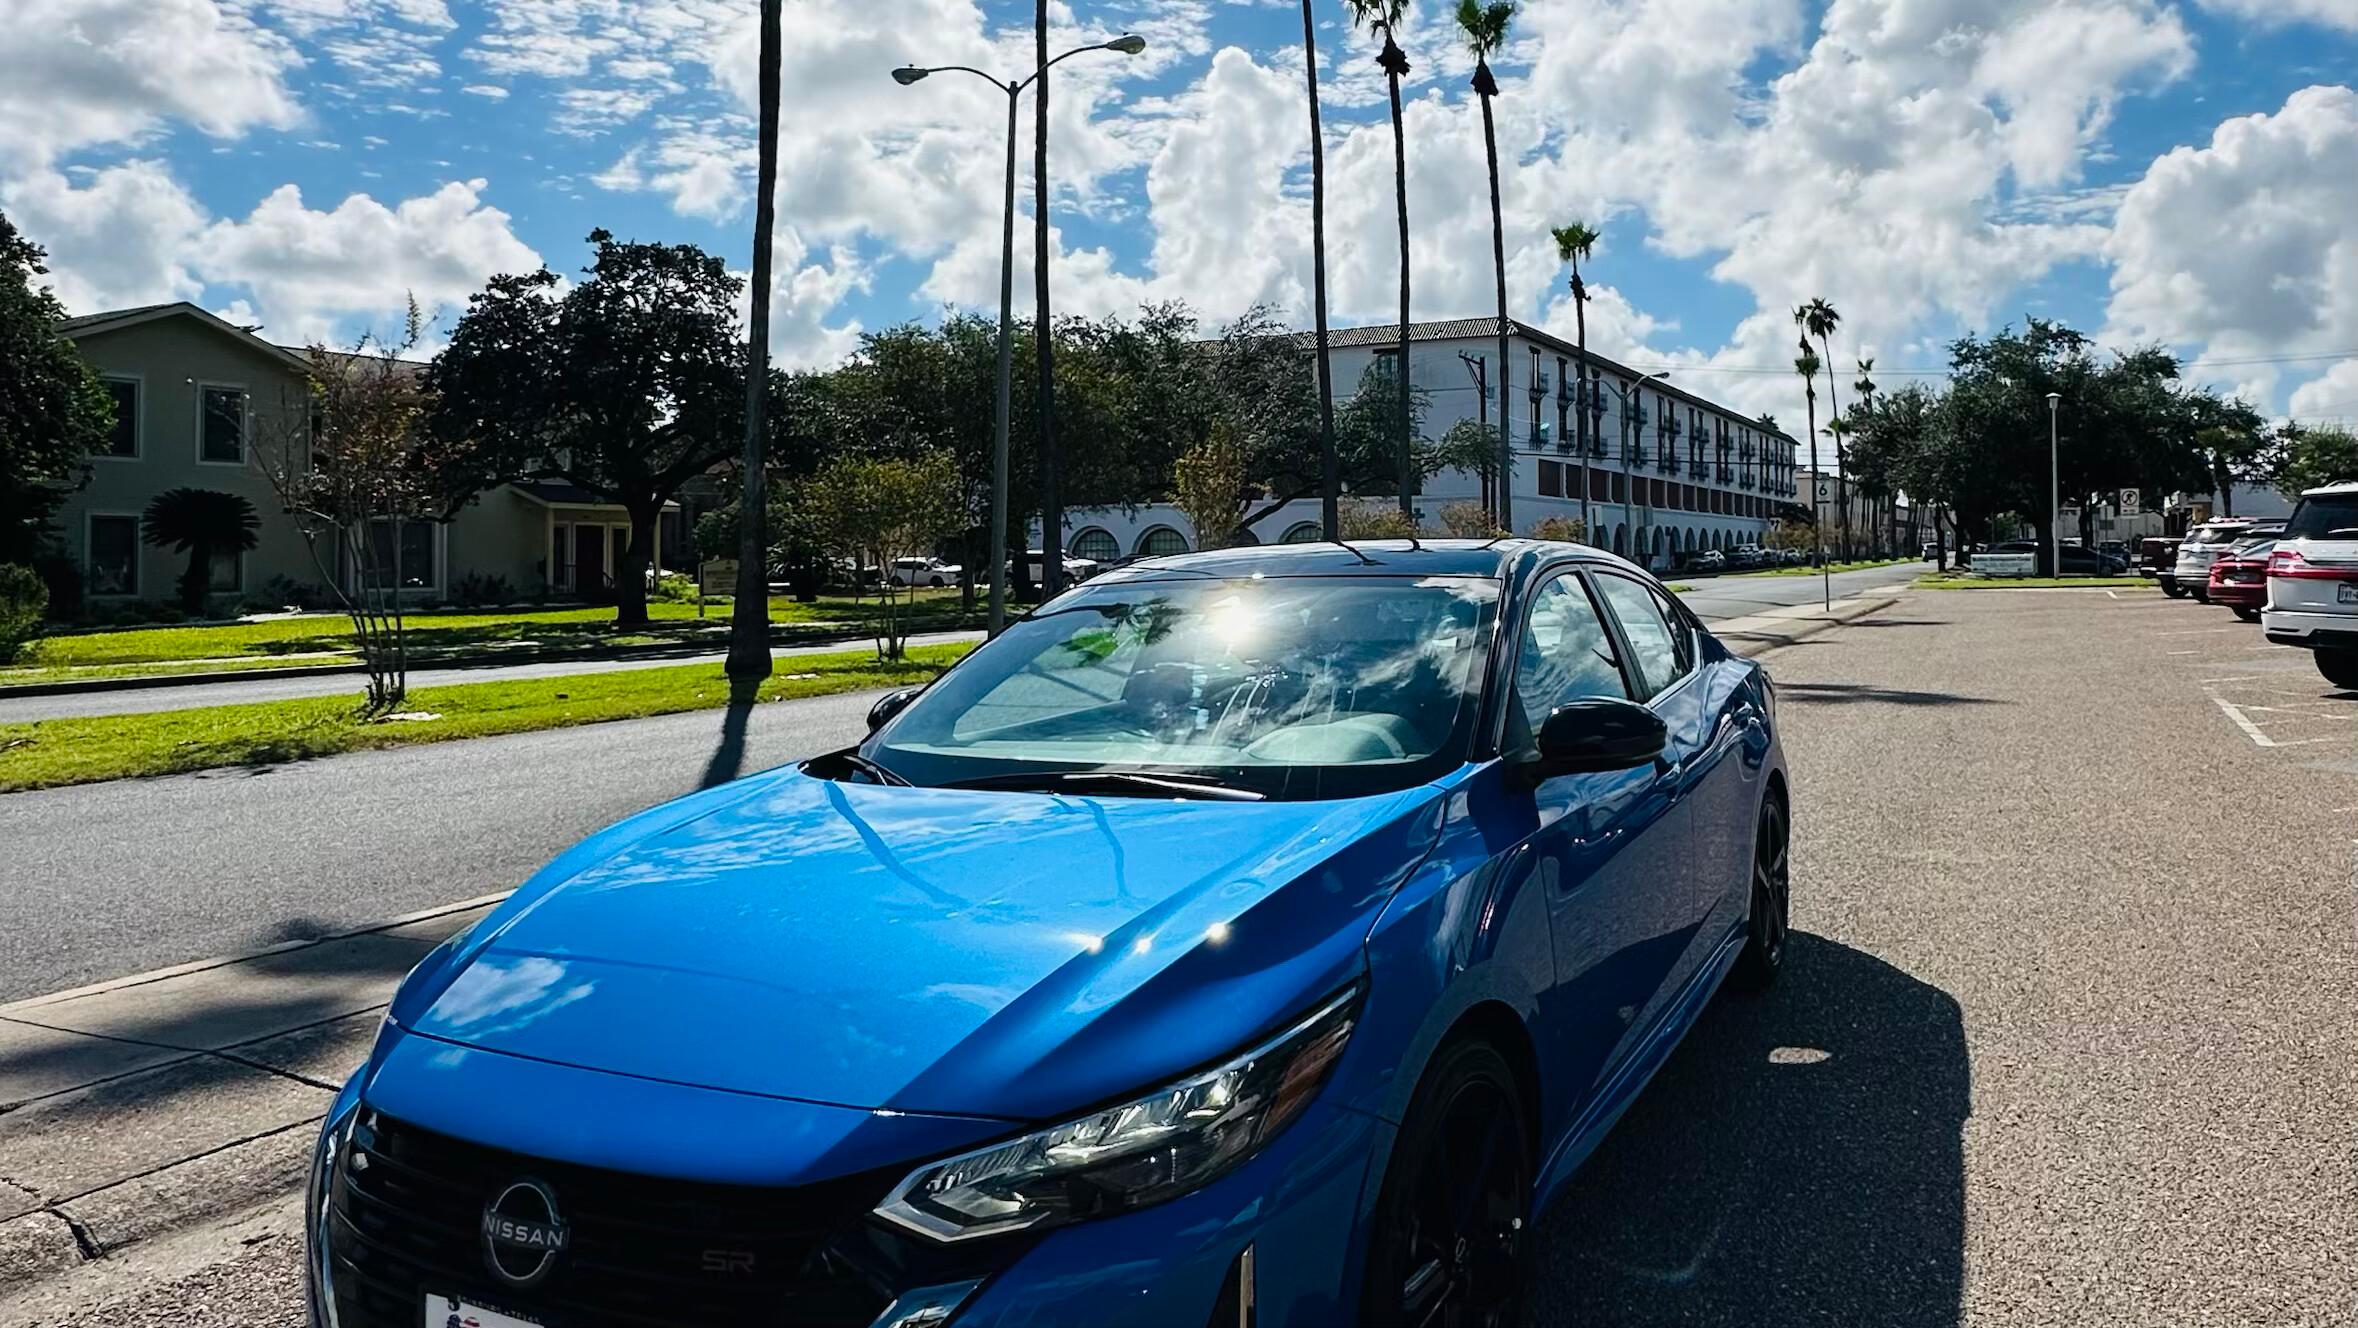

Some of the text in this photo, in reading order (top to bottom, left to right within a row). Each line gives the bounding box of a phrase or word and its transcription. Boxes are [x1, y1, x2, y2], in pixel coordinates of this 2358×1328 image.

[1819, 484, 1828, 496] 6
[484, 1215, 564, 1247] NISSAN
[702, 1249, 755, 1273] SR
